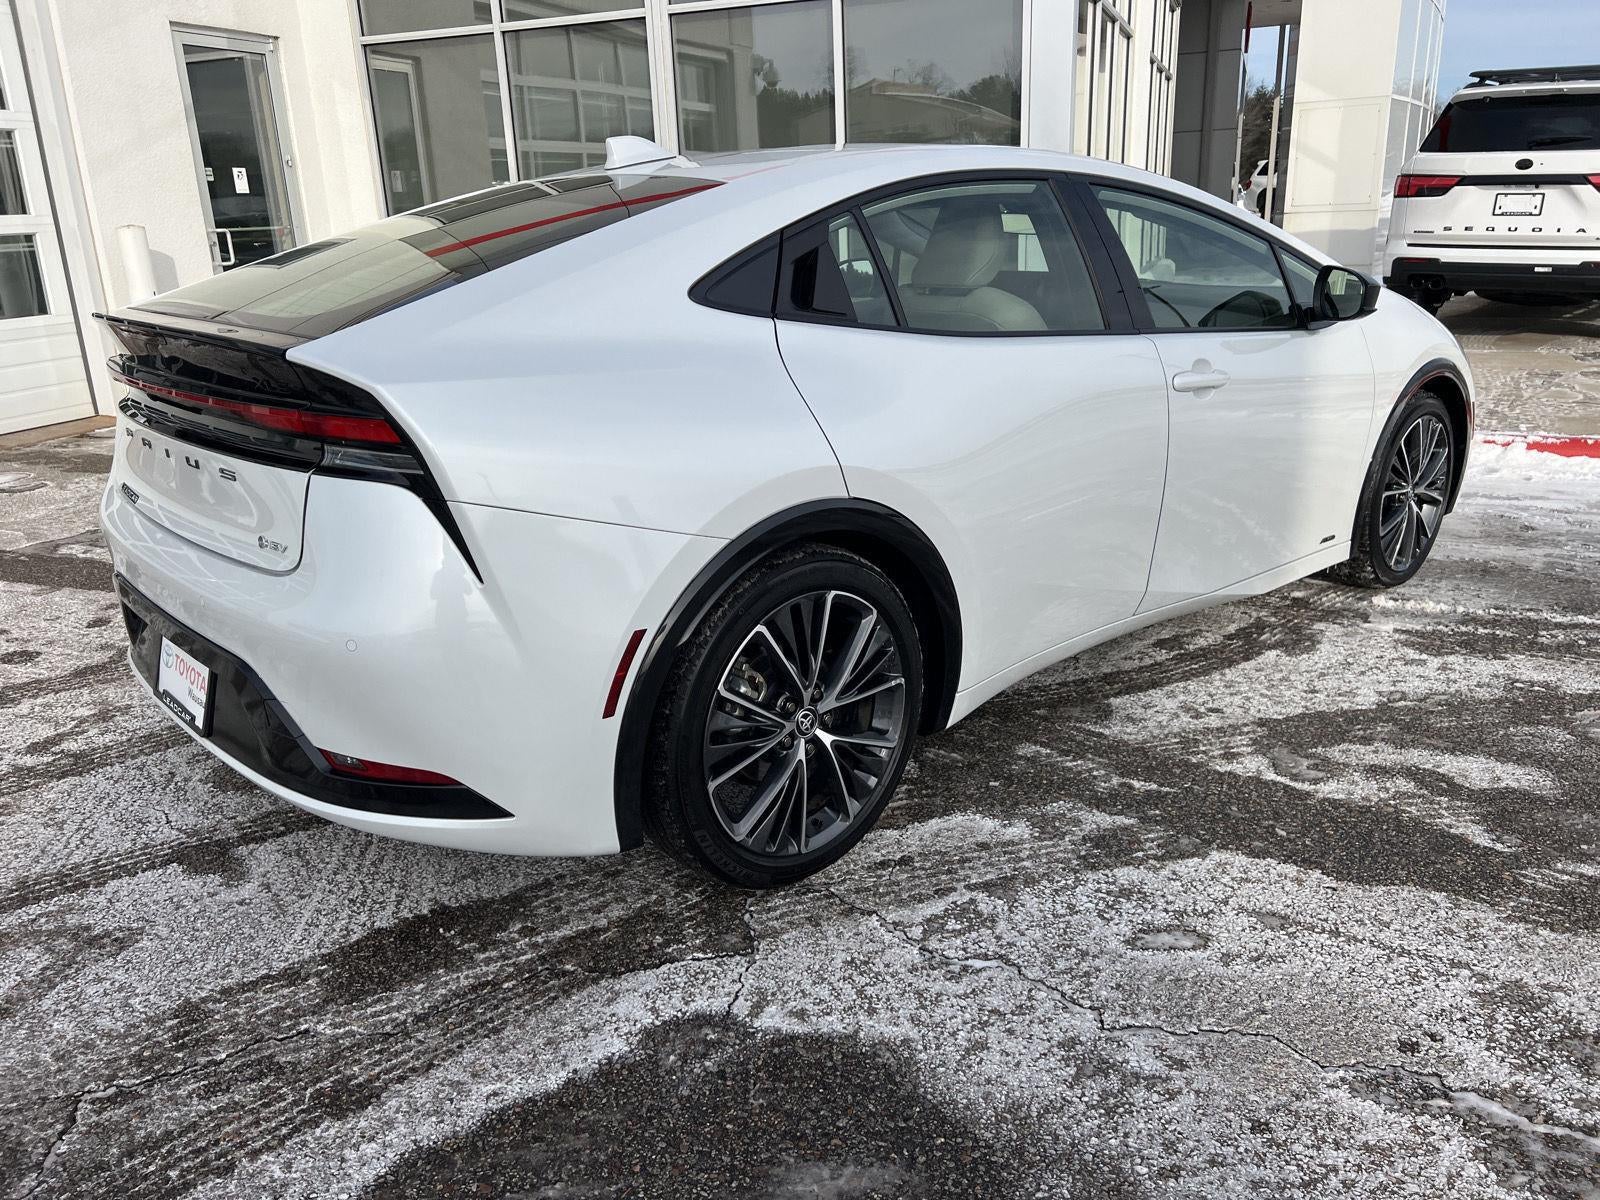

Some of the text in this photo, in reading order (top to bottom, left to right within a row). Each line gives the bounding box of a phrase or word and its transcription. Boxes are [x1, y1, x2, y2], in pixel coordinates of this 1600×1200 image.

[125, 427, 237, 482] PRIUS
[174, 653, 208, 695] TOYOTA
[163, 693, 191, 722] LEADCAR
[187, 686, 205, 710] Wausa
